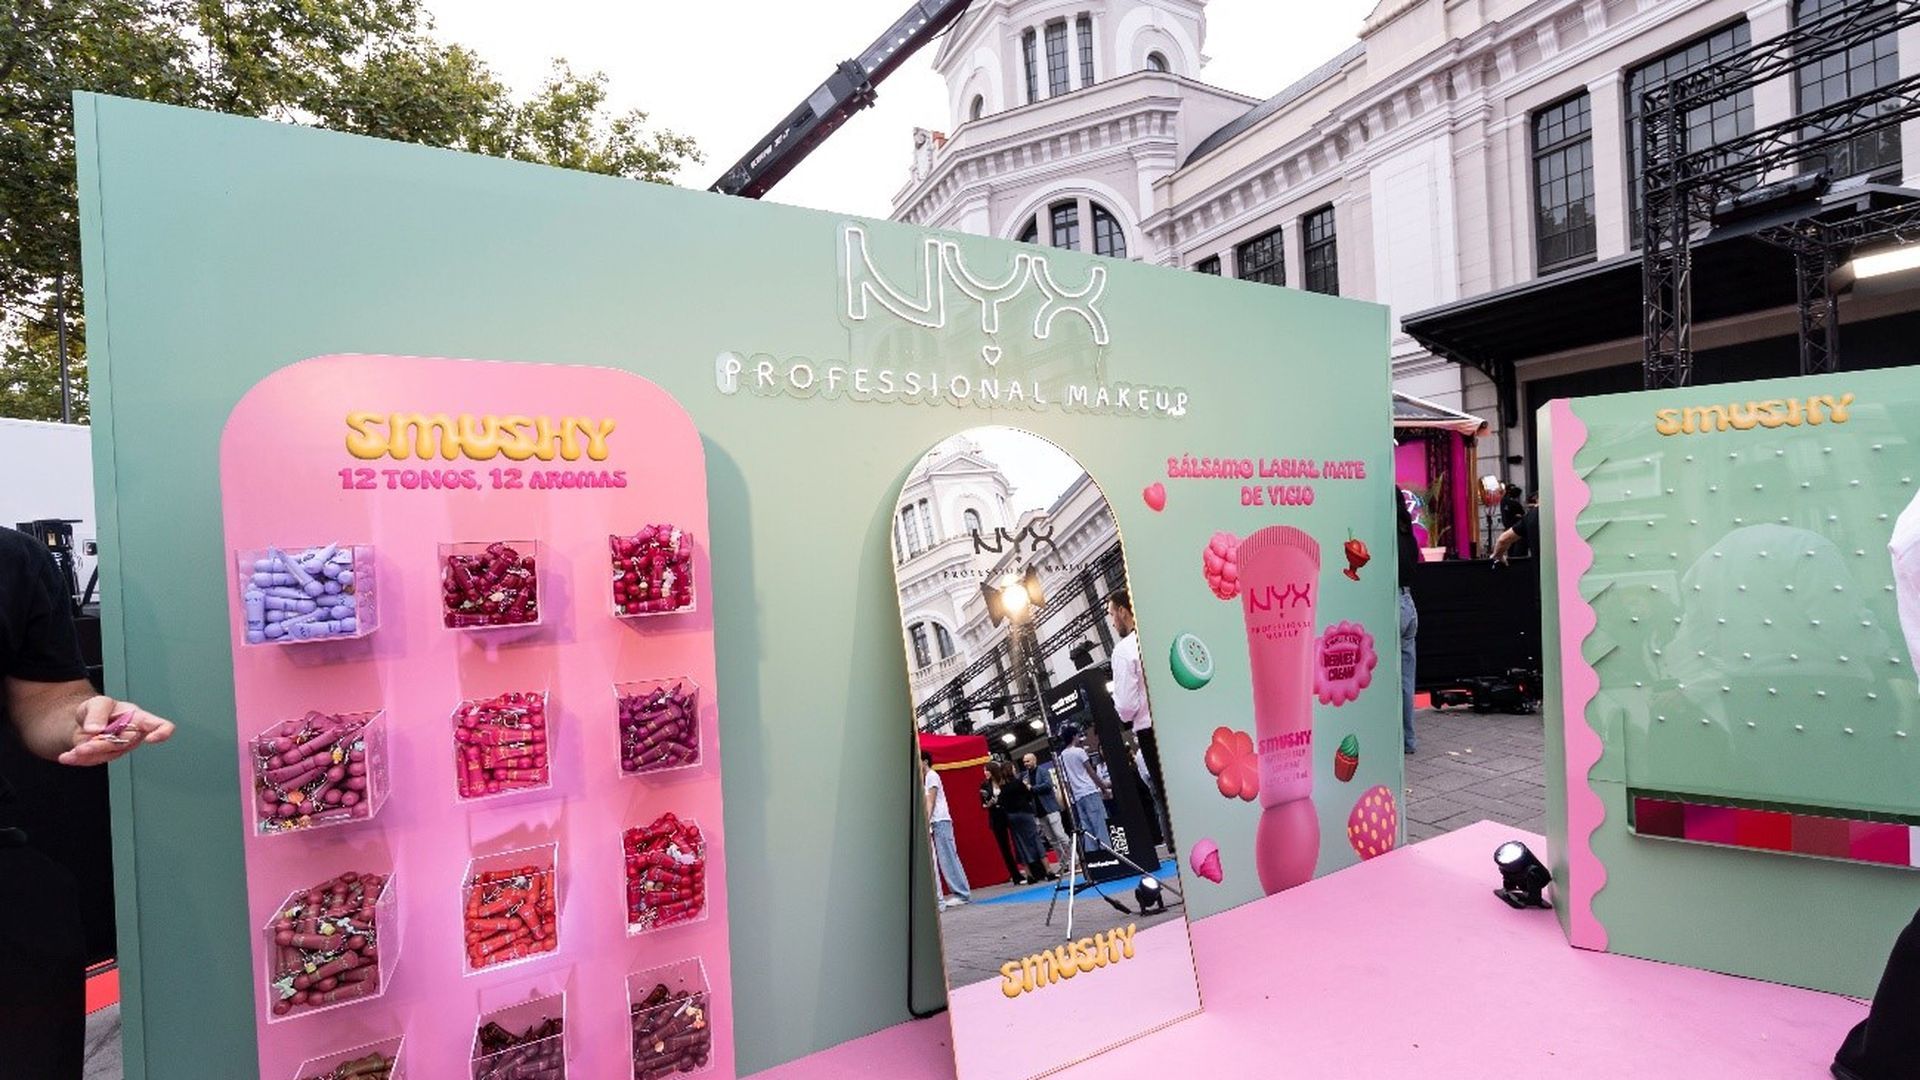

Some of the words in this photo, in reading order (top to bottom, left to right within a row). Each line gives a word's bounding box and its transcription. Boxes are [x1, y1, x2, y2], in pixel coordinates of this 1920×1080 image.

[846, 227, 1109, 344] NYX
[723, 359, 1046, 404] PROFESSIONAL
[1067, 384, 1189, 412] MAKEUP
[1656, 392, 1855, 437] SMUSHY
[345, 410, 616, 461] SMUSHY
[338, 468, 377, 489] 12
[381, 469, 483, 491] TONOS,
[489, 468, 524, 489] 12
[529, 470, 627, 489] AROMAS
[1167, 452, 1254, 479] BÁLSAMO
[1259, 458, 1320, 479] LABIAL
[1323, 460, 1366, 479] MATE
[1241, 486, 1264, 506] DE
[1267, 485, 1315, 506] VICIO
[972, 525, 1060, 555] NYX
[1250, 583, 1311, 613] NYX
[1258, 729, 1312, 756] SMUSHY
[1001, 922, 1136, 998] SMUSHY
